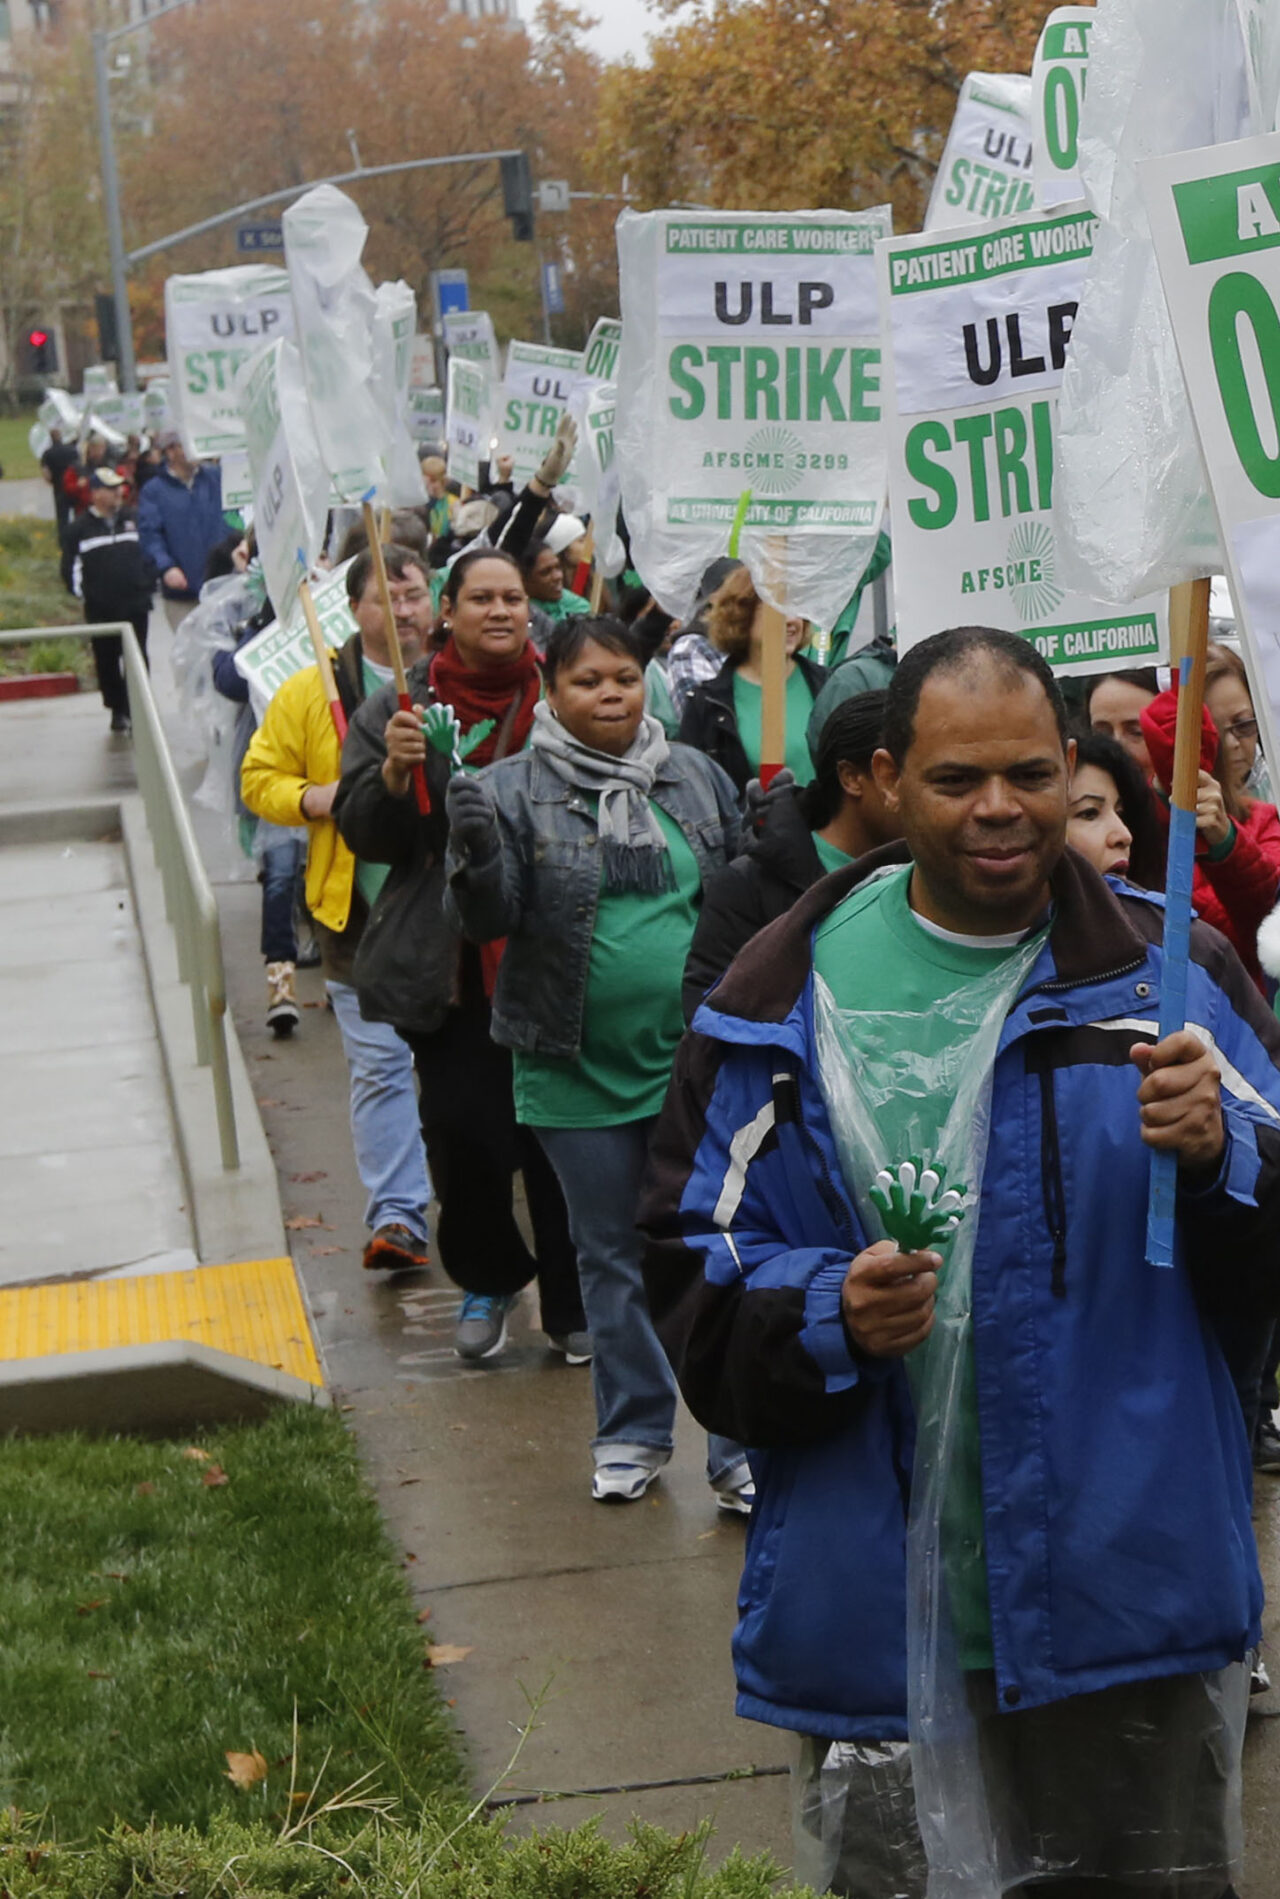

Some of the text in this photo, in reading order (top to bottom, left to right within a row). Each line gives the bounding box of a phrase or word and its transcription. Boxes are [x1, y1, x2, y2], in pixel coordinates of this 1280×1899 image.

[1044, 66, 1088, 170] O
[984, 128, 1033, 169] UL
[668, 229, 739, 249] PATIENT
[743, 229, 788, 249] CARE
[893, 218, 1099, 287] PATIENT CARE WORKE
[211, 309, 280, 337] ULP
[715, 281, 835, 325] ULP
[585, 339, 619, 380] ON
[962, 301, 1079, 386] ULP
[532, 377, 568, 401] UL
[668, 344, 882, 422] STRIKE
[702, 452, 849, 470] AFSCME 3299
[905, 400, 1053, 530] STRI
[263, 465, 283, 527] ULP
[690, 504, 770, 521] UNIVESITY
[774, 506, 792, 523] OF
[797, 505, 872, 523] CALIFORNIA
[961, 560, 1042, 594] AFSCME
[1035, 623, 1156, 659] OF CALIFORNIA
